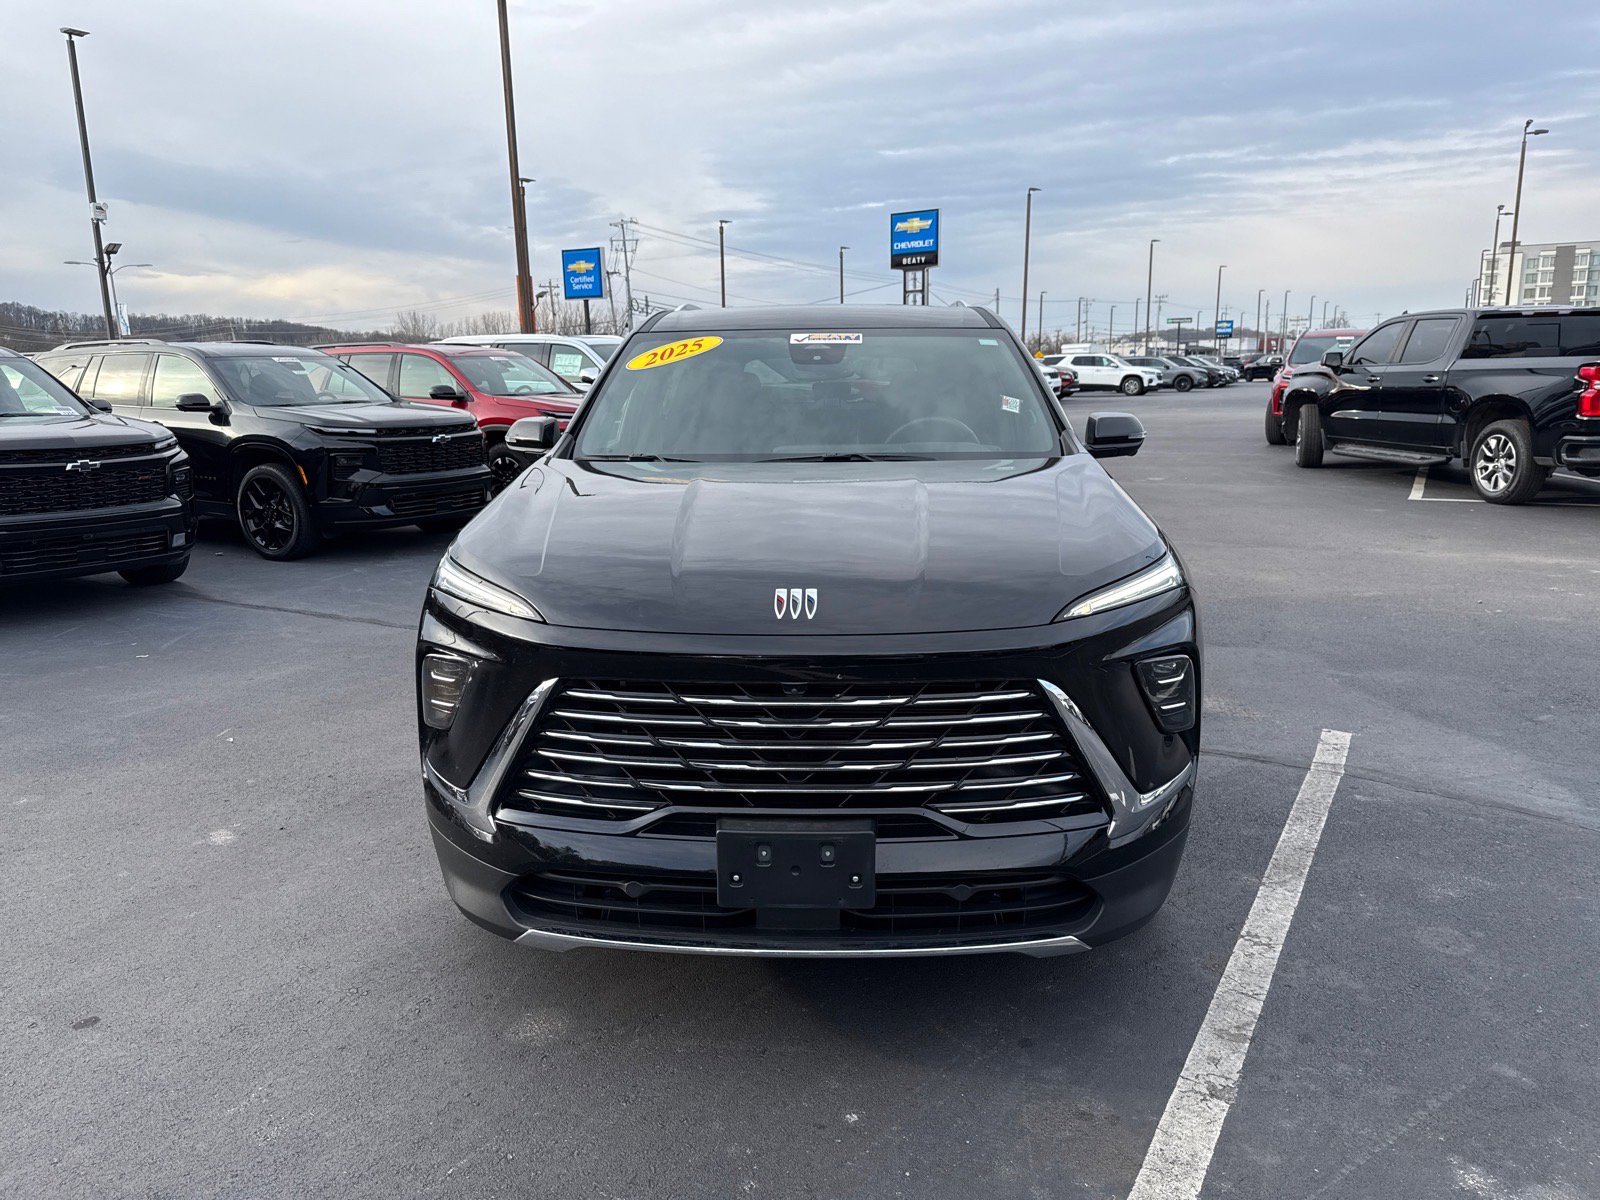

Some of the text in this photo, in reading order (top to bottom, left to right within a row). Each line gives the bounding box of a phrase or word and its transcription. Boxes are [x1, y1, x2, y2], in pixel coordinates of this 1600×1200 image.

[893, 239, 934, 250] CHEVROLET
[902, 256, 926, 265] BEATY
[570, 275, 595, 284] Certified
[644, 338, 704, 367] 2025
